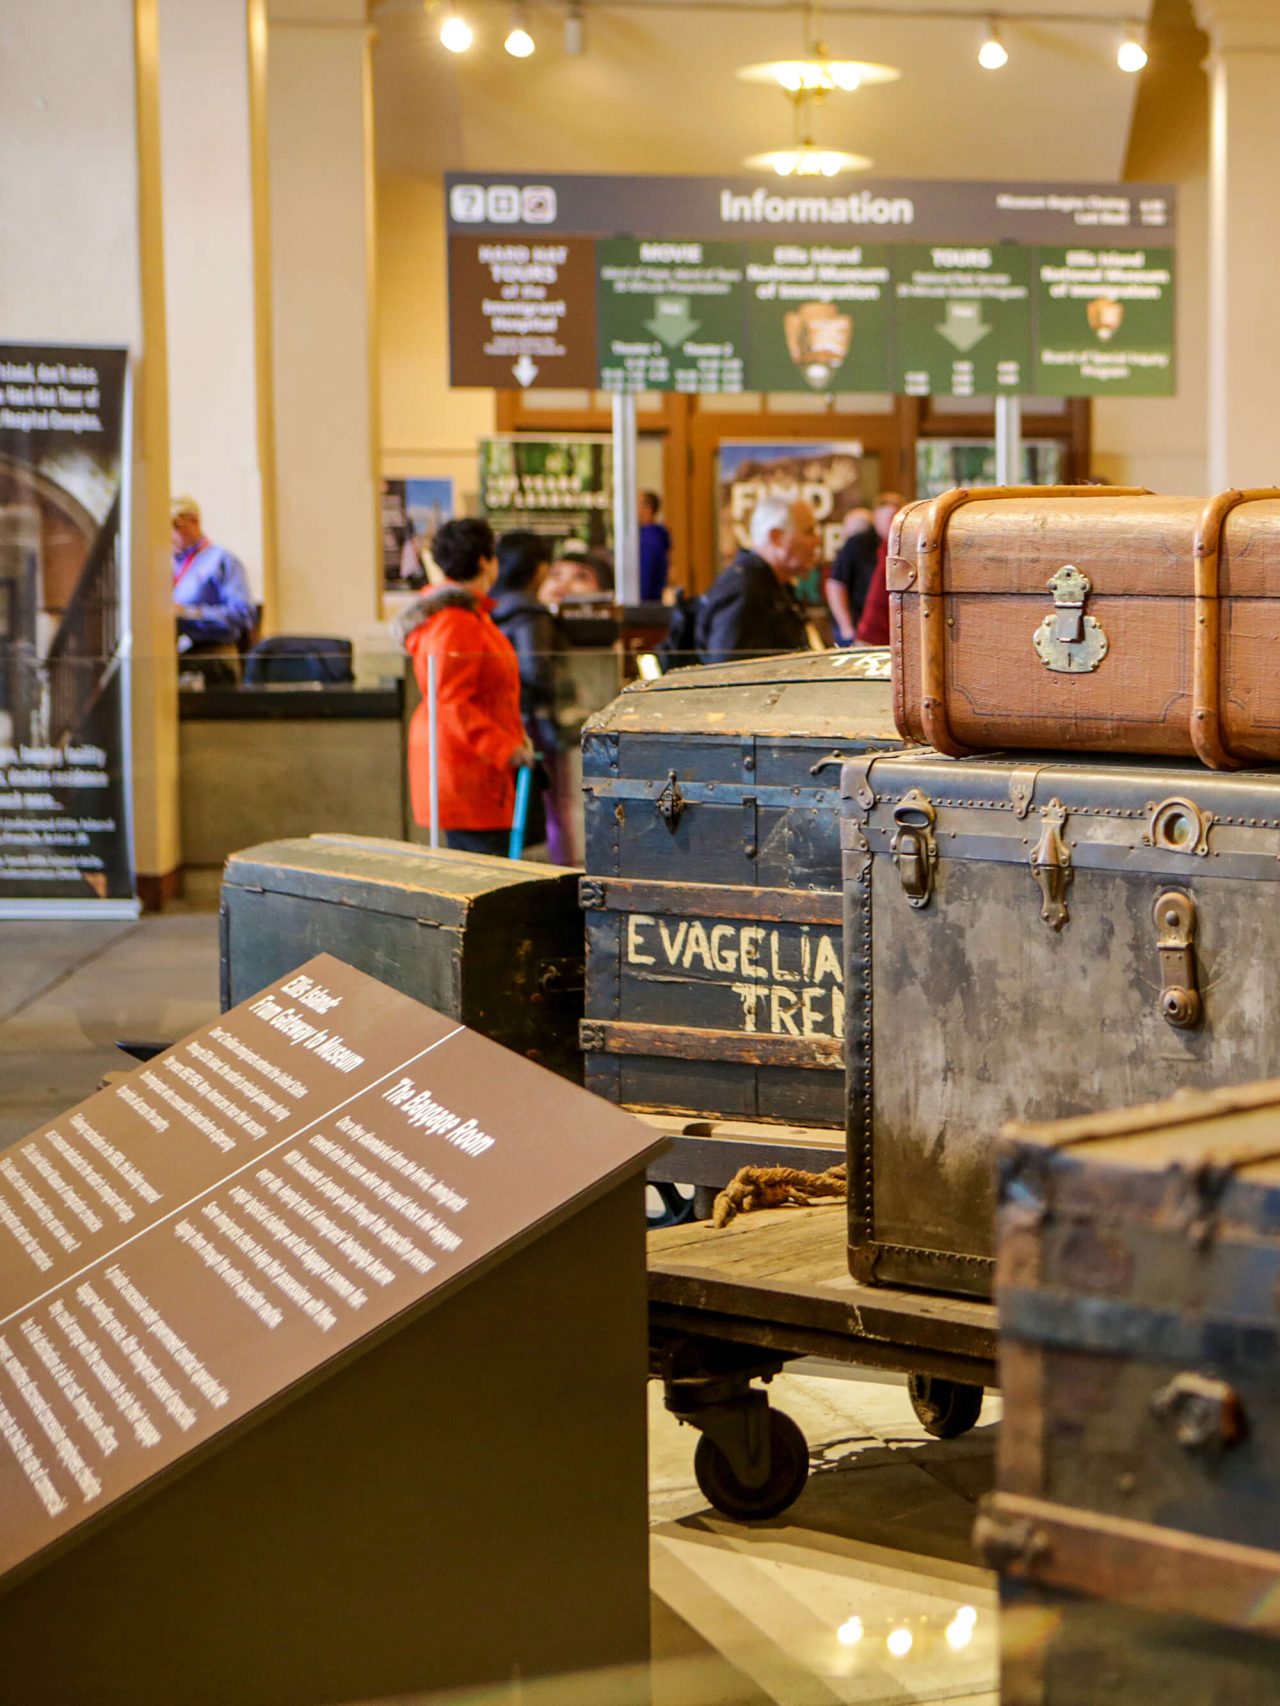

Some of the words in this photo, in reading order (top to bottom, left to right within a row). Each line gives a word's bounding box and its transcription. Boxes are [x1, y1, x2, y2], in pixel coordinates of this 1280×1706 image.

[720, 188, 914, 224] Information
[640, 243, 703, 263] MOVIE
[811, 247, 862, 265] Island
[931, 249, 992, 268] TOURS
[491, 265, 558, 283] TOURS
[747, 264, 816, 281] National
[501, 285, 519, 299] of
[756, 284, 776, 299] of
[778, 285, 880, 302] Immigration
[1049, 284, 1068, 299] of
[627, 914, 844, 983] EVAGELIA
[281, 975, 313, 998] Ellis
[298, 986, 342, 1014] Island:
[249, 995, 283, 1020] From
[270, 1008, 317, 1045] Gateway
[304, 1029, 329, 1049] to
[314, 1036, 365, 1072] Museum
[382, 1078, 415, 1105] The
[400, 1090, 461, 1135] Baggage
[446, 1119, 495, 1157] Room
